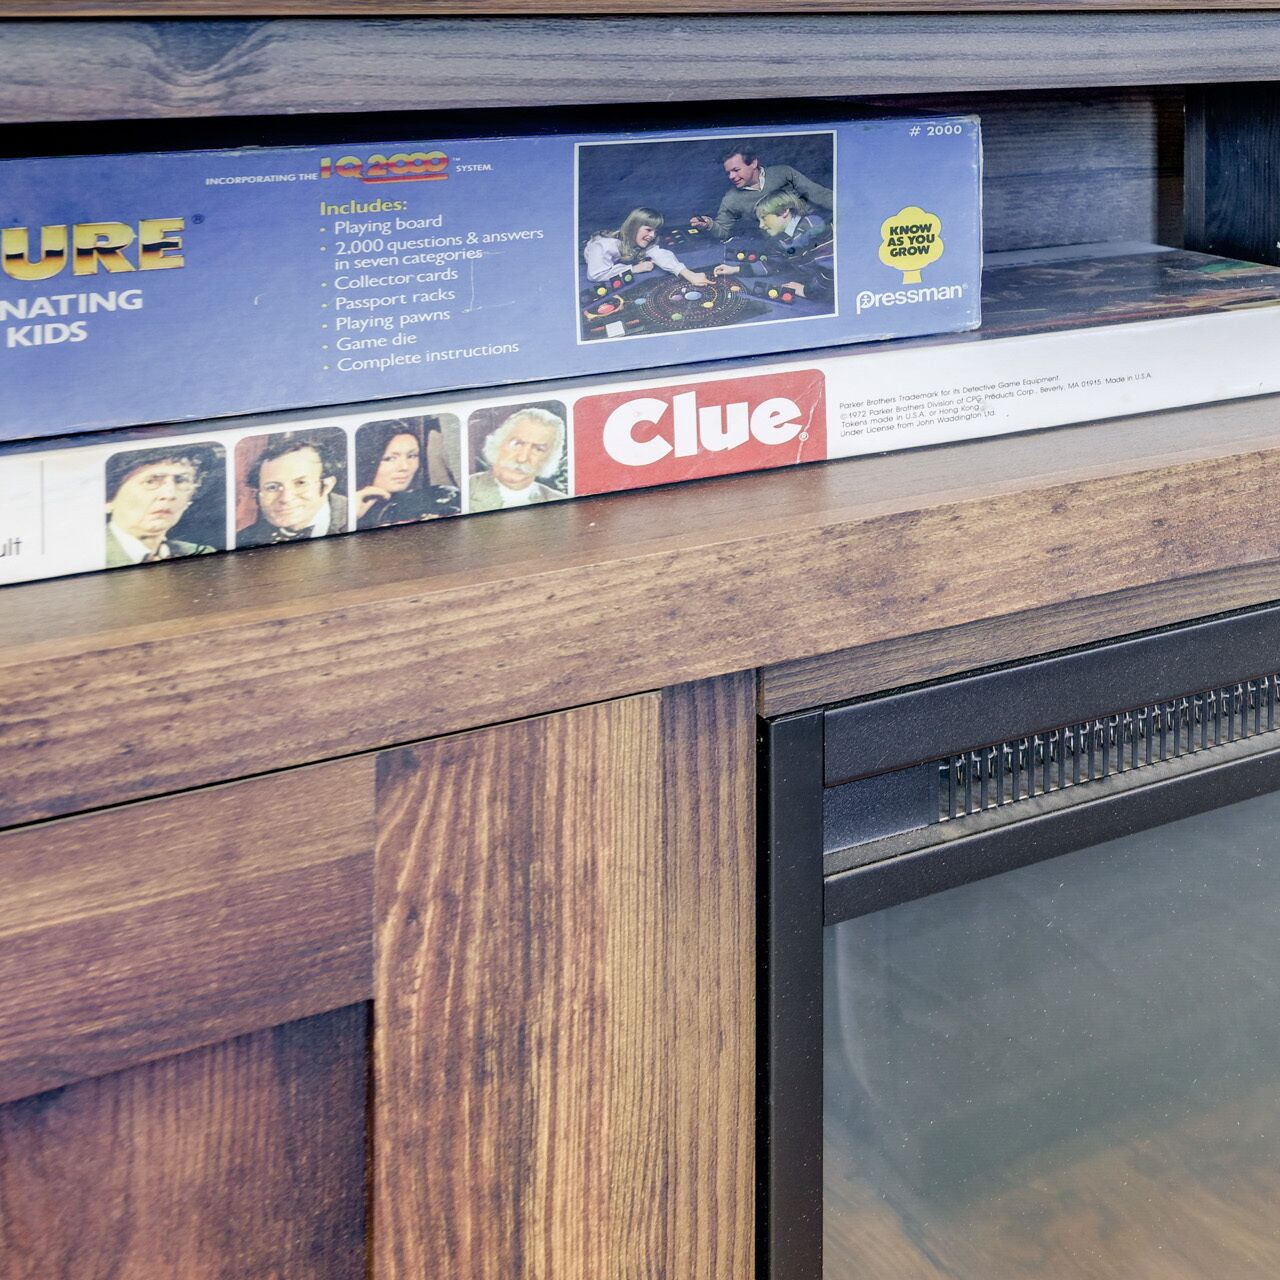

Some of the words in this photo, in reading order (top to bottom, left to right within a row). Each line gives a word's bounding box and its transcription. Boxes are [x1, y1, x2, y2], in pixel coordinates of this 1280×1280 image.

[927, 125, 962, 136] 2000
[206, 173, 297, 186] INCORPORATING
[298, 172, 318, 183] THE
[366, 150, 449, 177] 2000
[455, 163, 494, 173] SYSTEM.
[320, 198, 408, 216] Includes:
[335, 220, 392, 237] Playing
[396, 214, 442, 232] board
[889, 223, 933, 236] KNOW
[1, 217, 185, 281] URE
[335, 238, 384, 256] 2,000
[387, 234, 463, 254] questions
[466, 231, 479, 245] &
[482, 227, 545, 243] answers
[887, 236, 905, 247] AS
[907, 234, 936, 245] YOU
[889, 244, 931, 257] GROW
[335, 258, 350, 271] in
[354, 255, 399, 269] seven
[401, 248, 483, 266] categories
[334, 273, 413, 290] Collector
[416, 267, 459, 283] cards
[335, 293, 407, 311] Passport
[413, 288, 456, 303] racks
[856, 284, 963, 315] pressman
[336, 314, 394, 332] Playing
[400, 310, 451, 328] pawns
[6, 321, 88, 348] KIDS
[336, 335, 388, 351] Game
[392, 332, 417, 346] die
[336, 353, 423, 372] Complete
[426, 341, 520, 362] instructions
[839, 401, 864, 410] Parker
[866, 396, 897, 406] Brothers
[899, 391, 939, 402] Trademark
[962, 383, 996, 394] Detective
[998, 379, 1021, 389] Game
[869, 407, 894, 416] Parker
[895, 403, 925, 413] Brothers
[927, 399, 955, 408] Division
[984, 391, 1015, 401] Products
[1039, 384, 1066, 394] Beverly,
[1105, 376, 1126, 385] Made
[840, 428, 864, 438] Under
[866, 424, 895, 434] License
[897, 421, 915, 429] from
[916, 418, 935, 427] John
[937, 412, 983, 424] Waddington
[842, 420, 868, 429] Tokens
[870, 416, 894, 424] made
[939, 405, 960, 415] Hong
[603, 391, 804, 467] Clue
